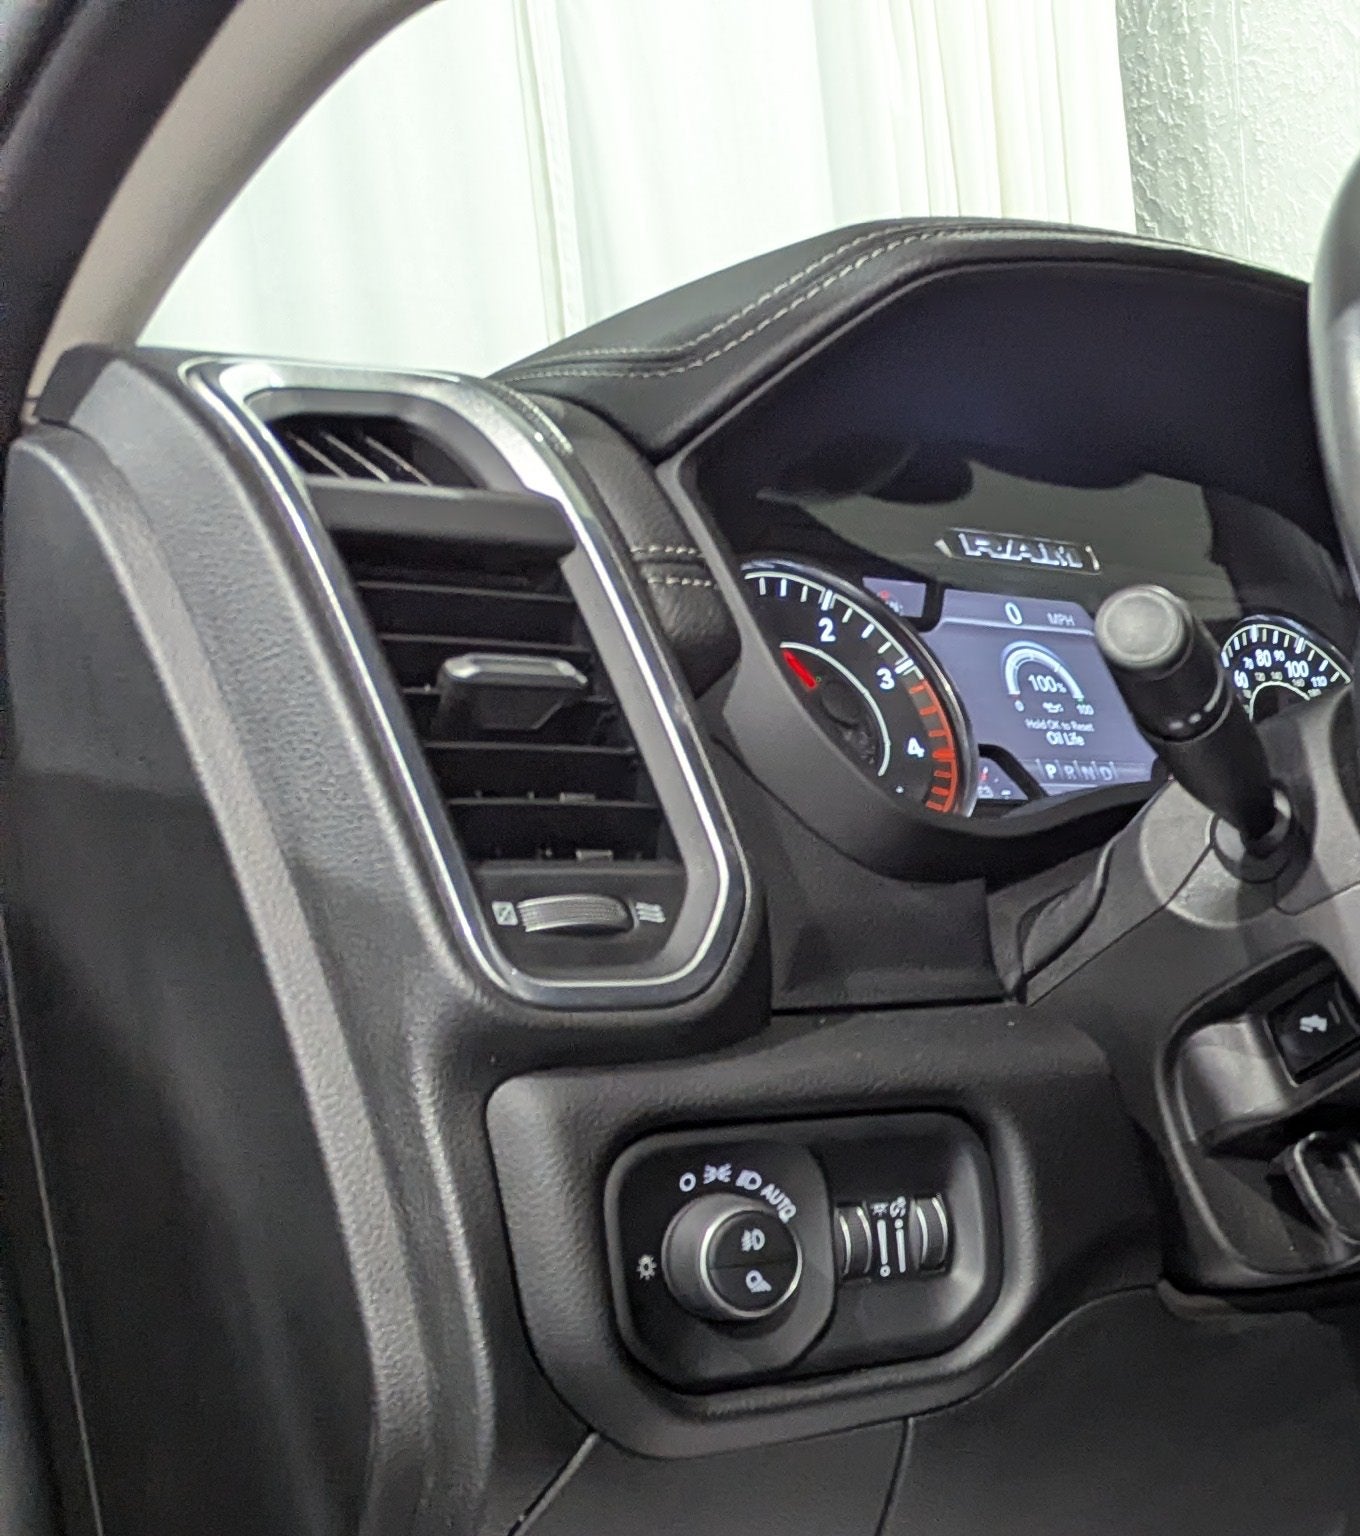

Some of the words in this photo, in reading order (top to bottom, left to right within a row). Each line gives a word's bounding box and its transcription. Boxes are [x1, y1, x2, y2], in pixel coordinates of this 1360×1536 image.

[1004, 601, 1023, 626] 0
[1046, 611, 1075, 627] MPH
[818, 617, 836, 642] 2
[1254, 648, 1272, 668] 80
[1284, 660, 1309, 678] 100
[876, 667, 895, 690] 3
[906, 737, 925, 758] 4
[1046, 730, 1064, 745] Oil
[1063, 731, 1085, 746] Life
[760, 1183, 797, 1224] AUTO
